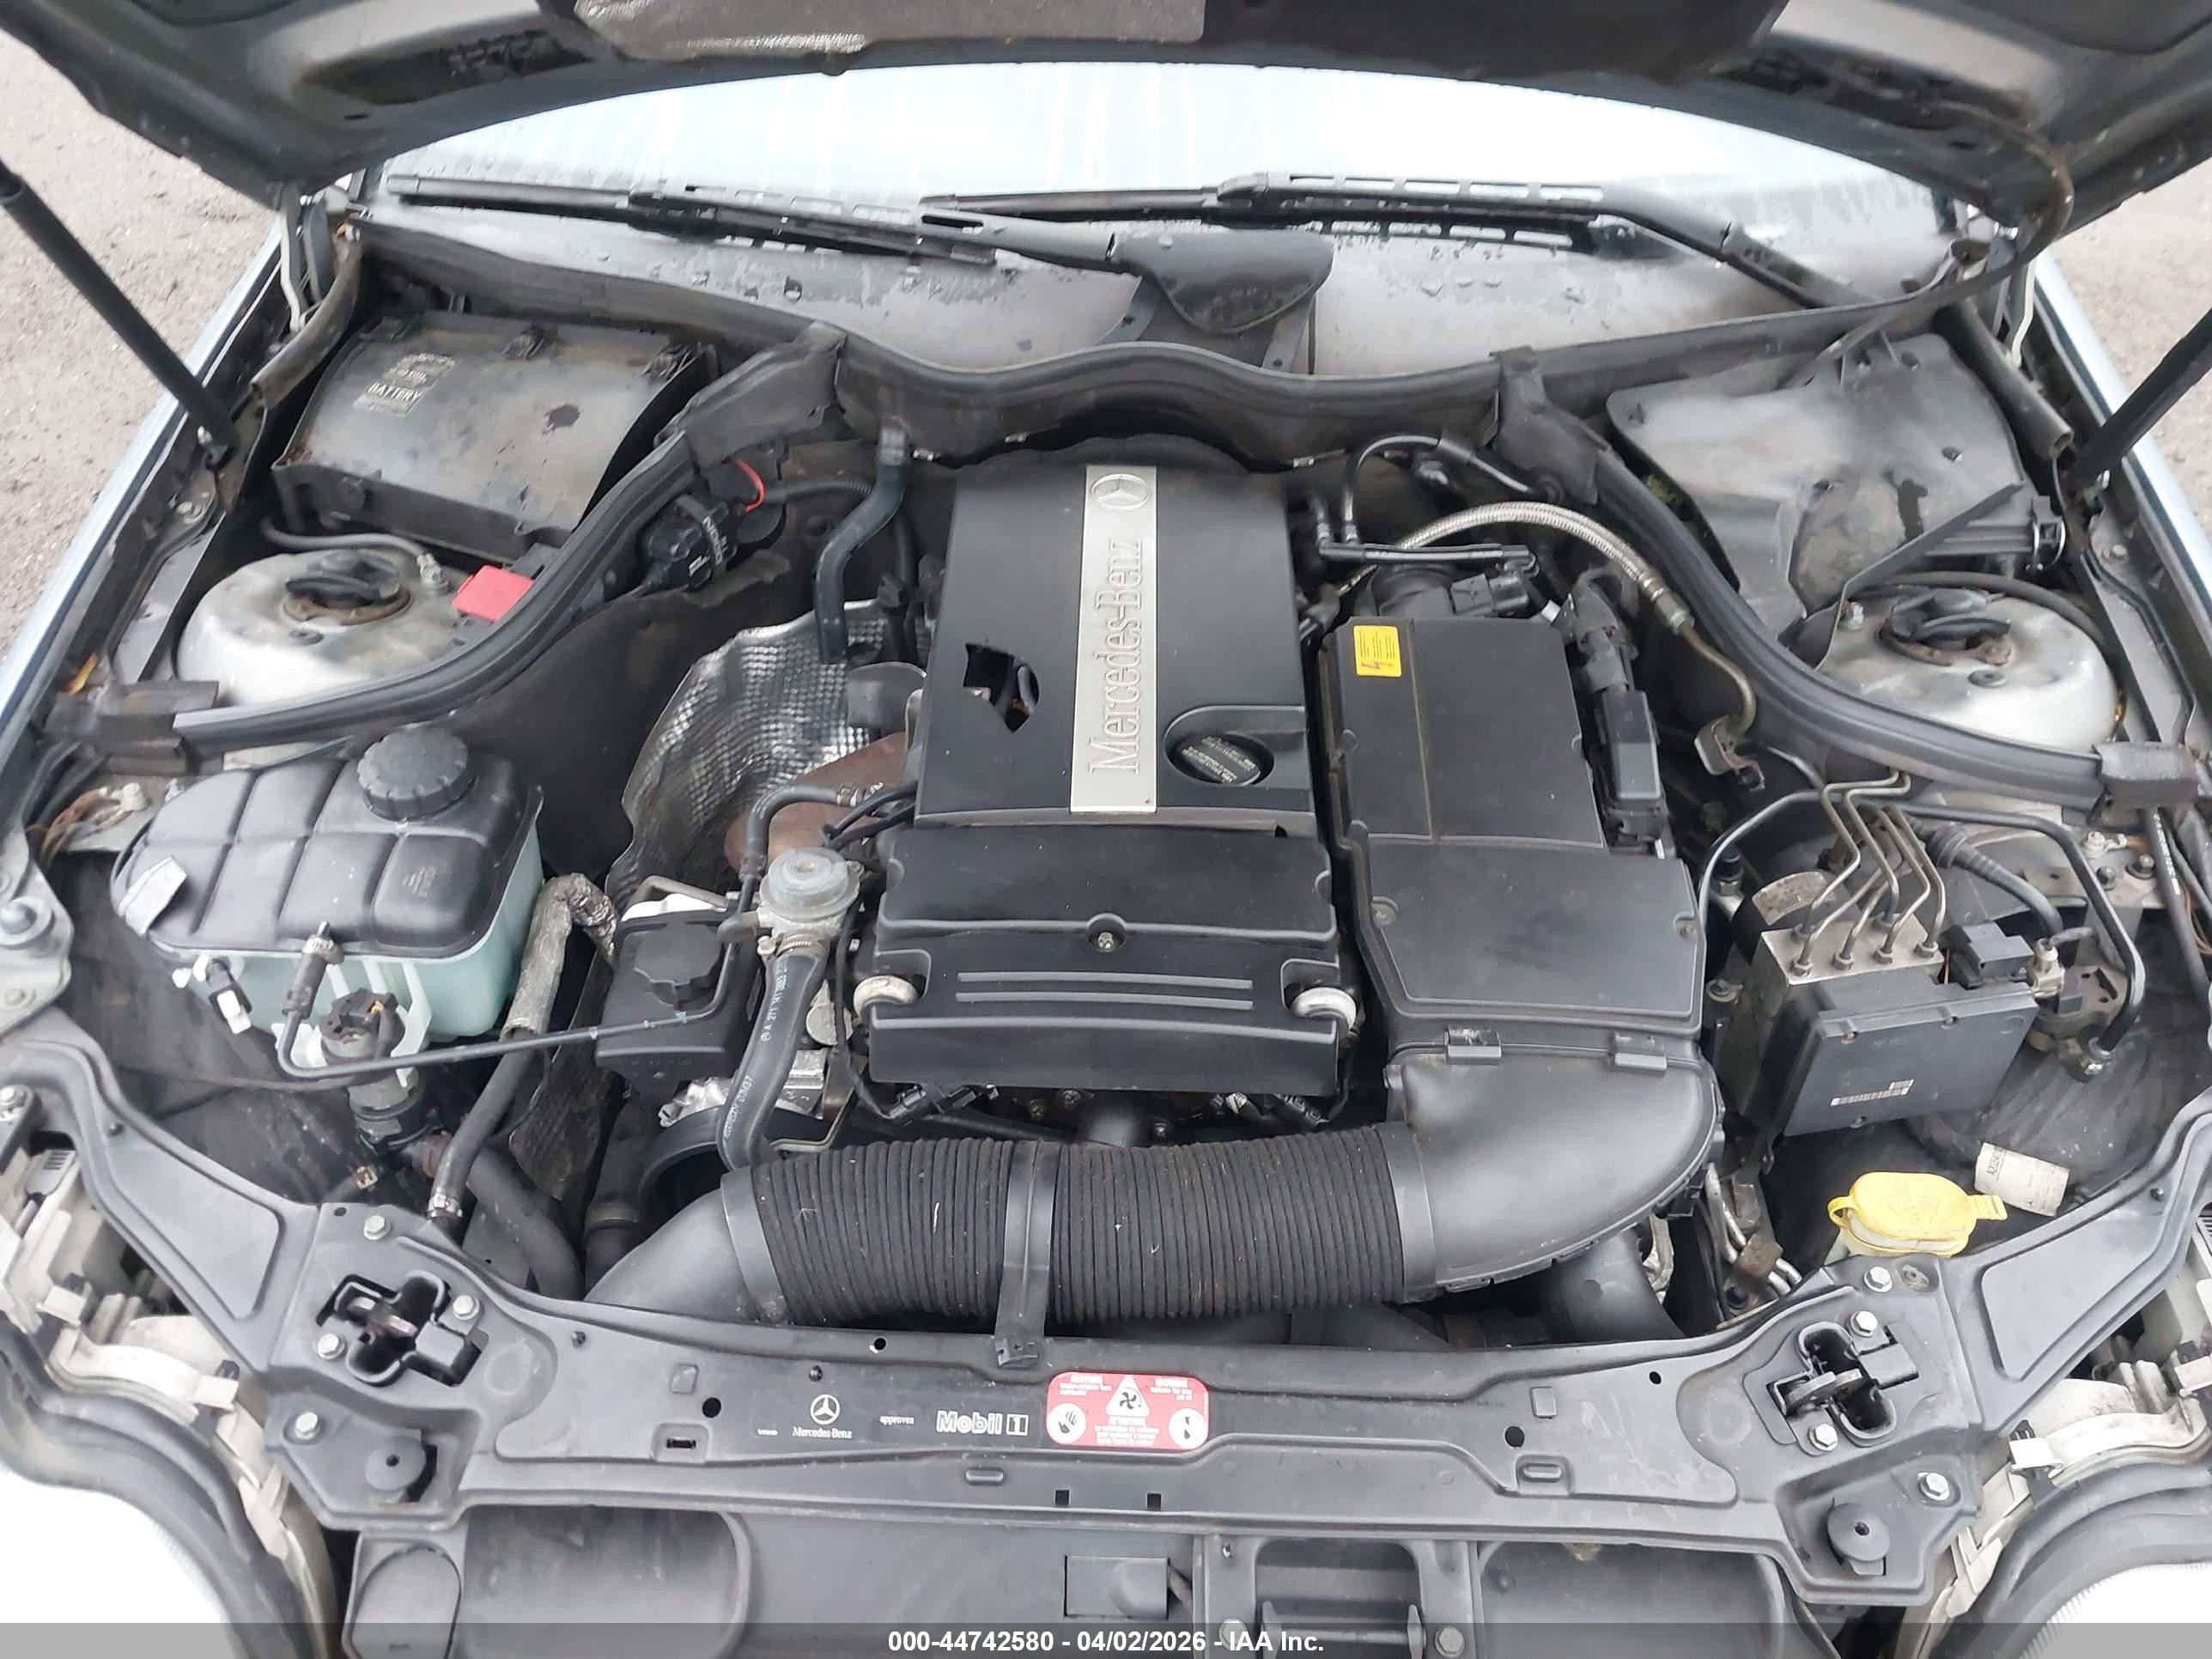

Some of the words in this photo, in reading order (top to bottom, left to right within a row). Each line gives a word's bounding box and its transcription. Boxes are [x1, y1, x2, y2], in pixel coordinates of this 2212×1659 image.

[368, 381, 422, 403] BATTERY
[1089, 538, 1142, 775] Mercedes-Benz
[879, 1415, 915, 1425] approves
[936, 1410, 1003, 1435] Mobil
[1006, 1413, 1030, 1437] 1
